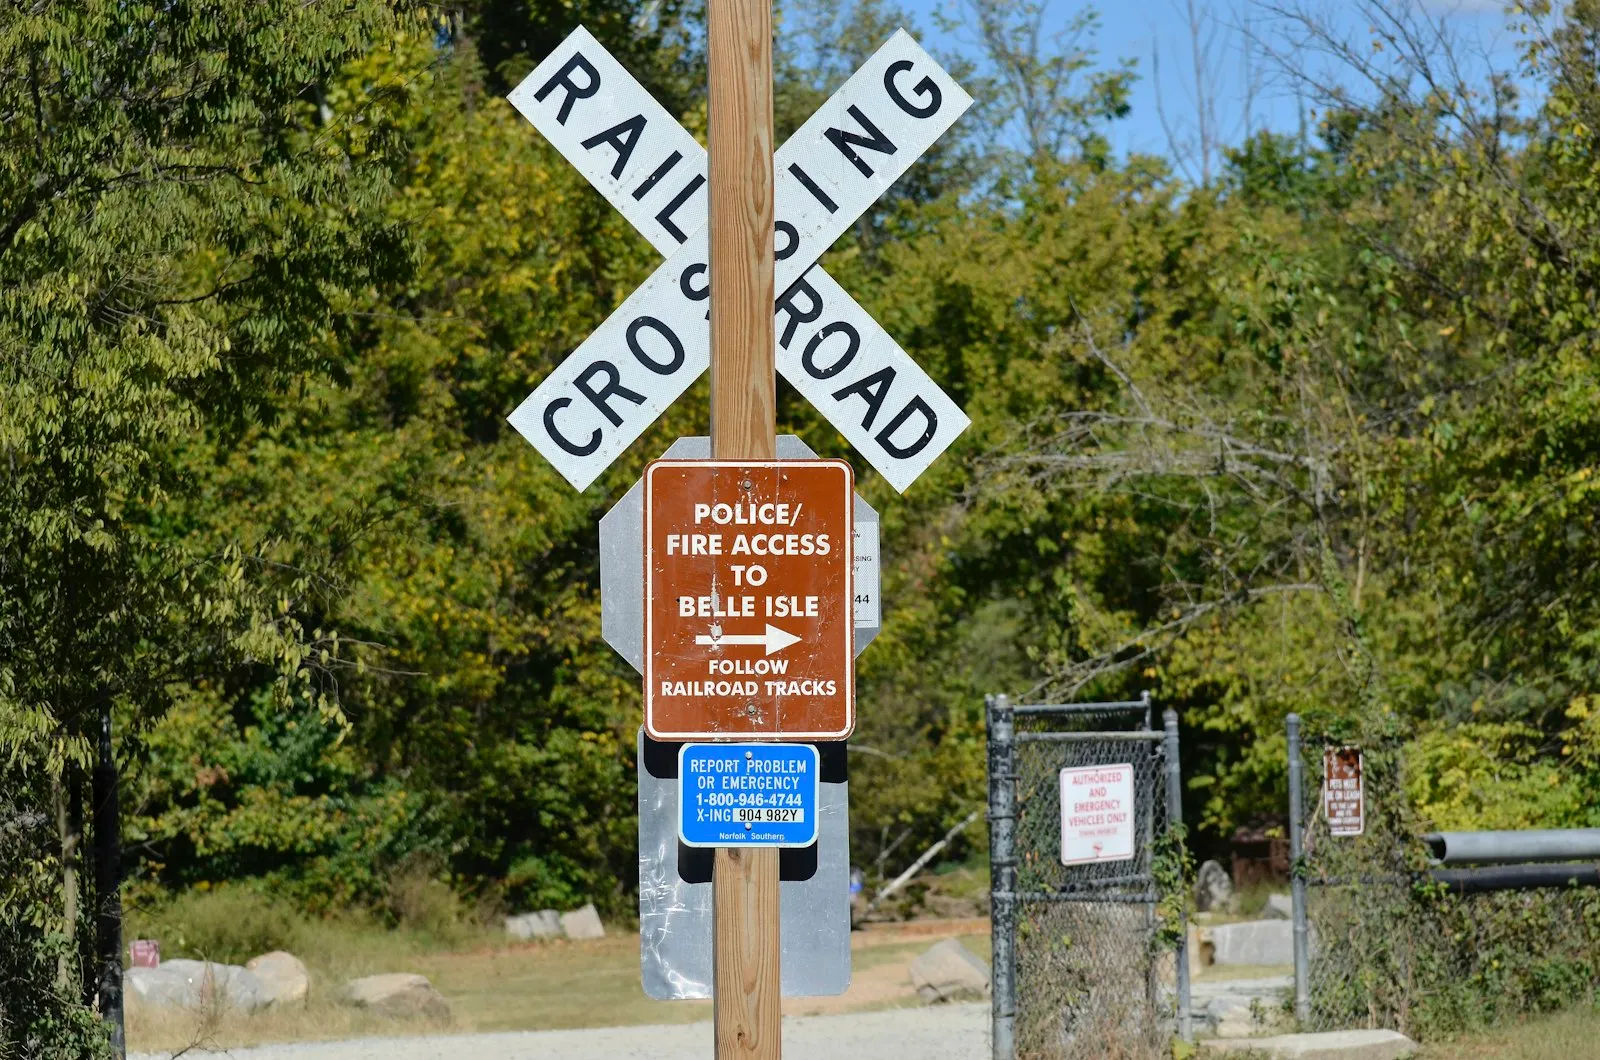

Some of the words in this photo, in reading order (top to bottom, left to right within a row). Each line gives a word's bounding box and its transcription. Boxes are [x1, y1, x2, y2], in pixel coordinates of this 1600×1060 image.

[694, 503, 802, 527] POLICE/
[666, 534, 722, 556] FIRE
[731, 534, 831, 556] ACCESS
[730, 565, 768, 586] TO
[679, 596, 755, 617] BELLE
[765, 595, 819, 617] ISLE
[708, 659, 789, 675] FOLLOW
[661, 681, 758, 696] RAILROAD
[765, 681, 837, 696] TRACKS
[690, 759, 740, 773] REPORT
[746, 759, 807, 774] PROBLEM
[697, 776, 715, 789] OR
[722, 776, 800, 790] EMERGENCY
[1072, 772, 1122, 785] AUTHORIZED
[1089, 787, 1107, 797] AND
[696, 793, 802, 806] 1-800-946-4744
[1074, 800, 1120, 813] EMERGENCY
[697, 809, 731, 822] X-ING
[739, 809, 762, 822] 904
[766, 809, 798, 822] 982Y
[1069, 814, 1105, 827] VEHICLES
[1107, 813, 1127, 824] ONLY
[719, 832, 746, 840] Norfolk
[751, 832, 785, 840] Southern
